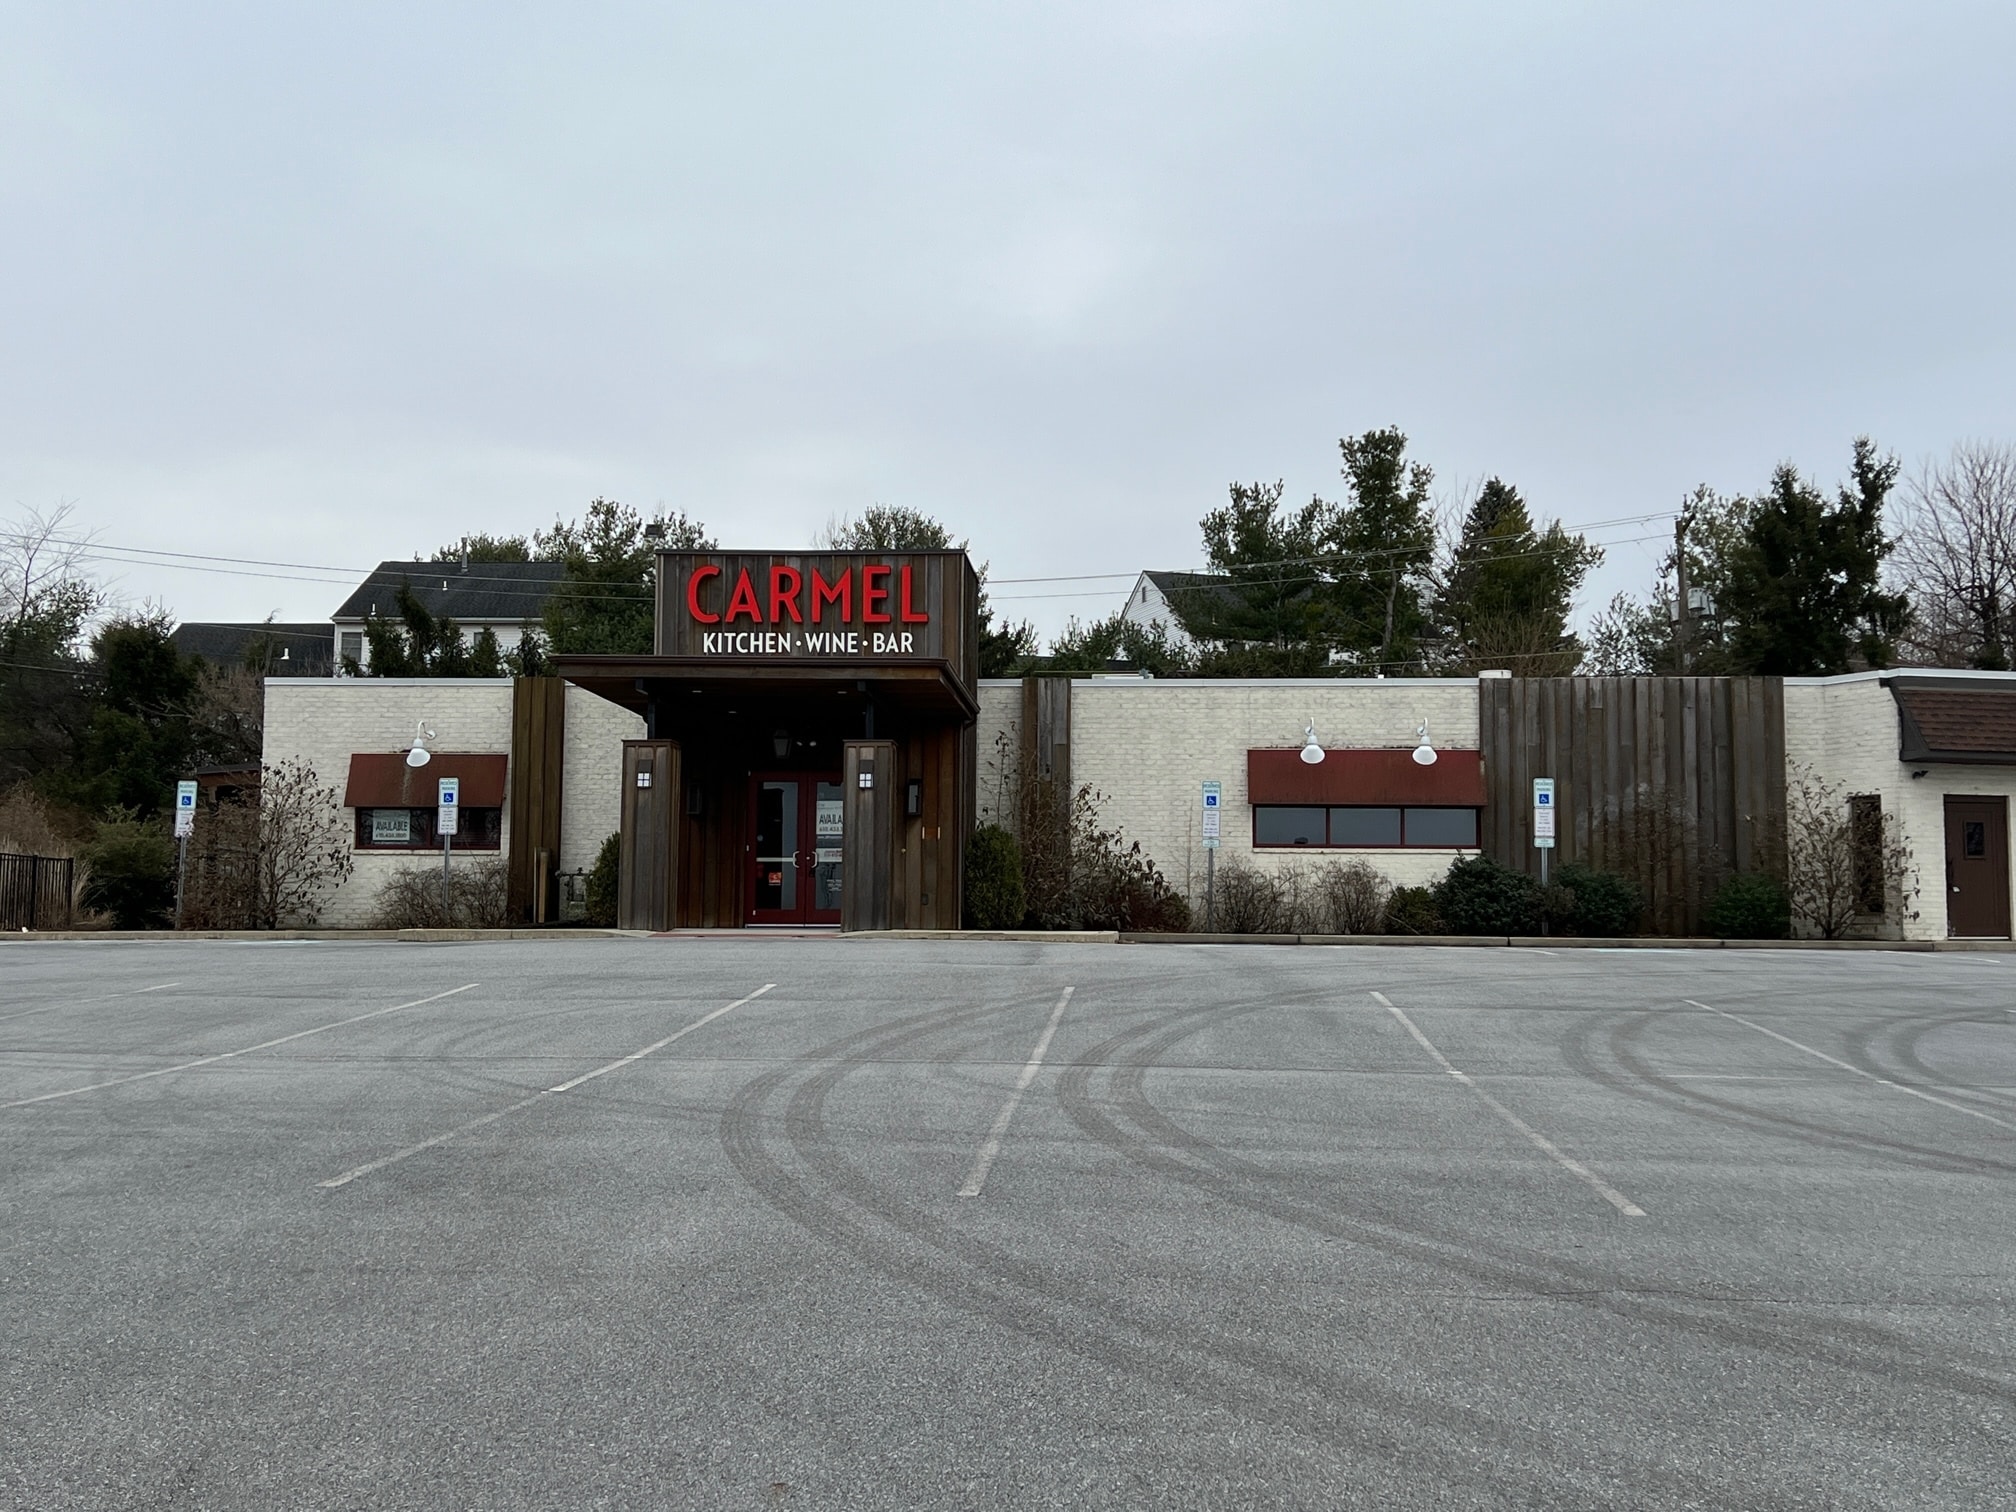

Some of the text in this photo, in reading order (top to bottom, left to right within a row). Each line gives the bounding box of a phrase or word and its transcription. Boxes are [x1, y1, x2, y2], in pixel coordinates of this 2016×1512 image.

[687, 565, 929, 624] CARMEL
[703, 632, 914, 653] KITCHEN WINE BAR
[375, 821, 408, 831] AVAILABLE
